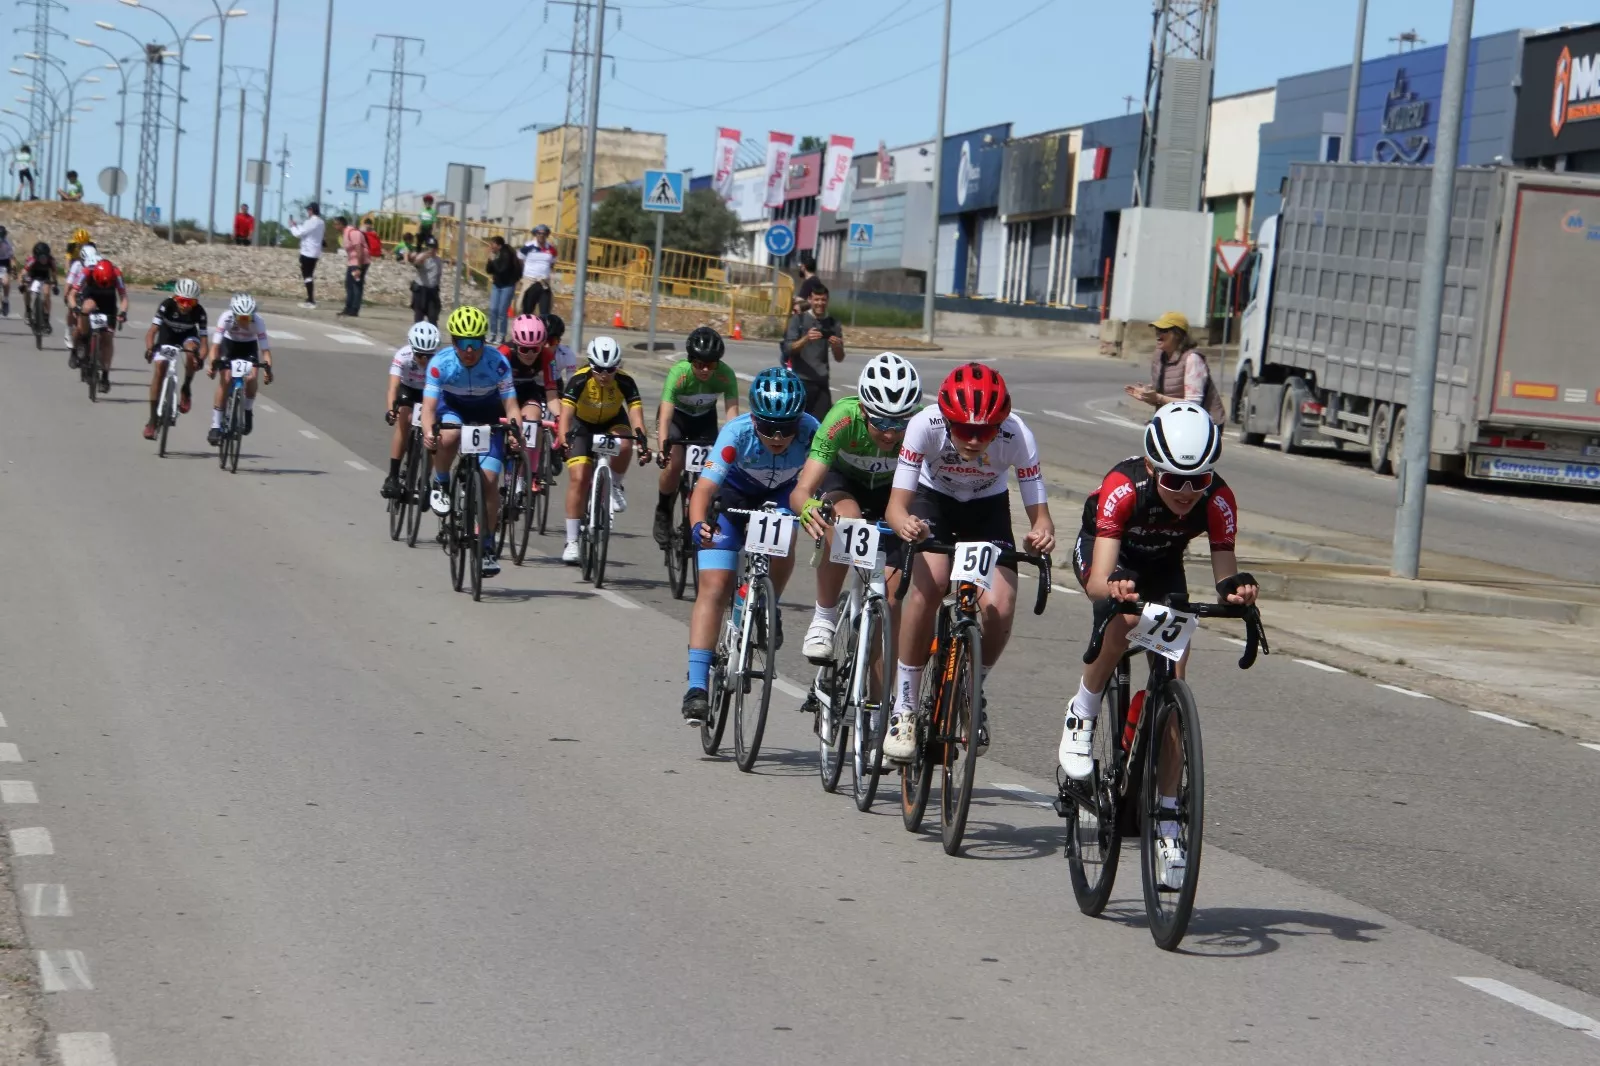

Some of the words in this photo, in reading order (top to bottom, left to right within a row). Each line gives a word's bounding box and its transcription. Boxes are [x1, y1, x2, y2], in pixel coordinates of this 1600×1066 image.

[236, 361, 247, 373] 27
[472, 428, 480, 447] 6
[598, 437, 615, 450] 26
[691, 448, 709, 466] 22
[1103, 482, 1133, 518] SETEK
[1213, 495, 1235, 535] SETEK
[758, 516, 782, 546] 11
[843, 525, 870, 557] 13
[963, 545, 992, 577] 50
[1147, 610, 1189, 643] 15
